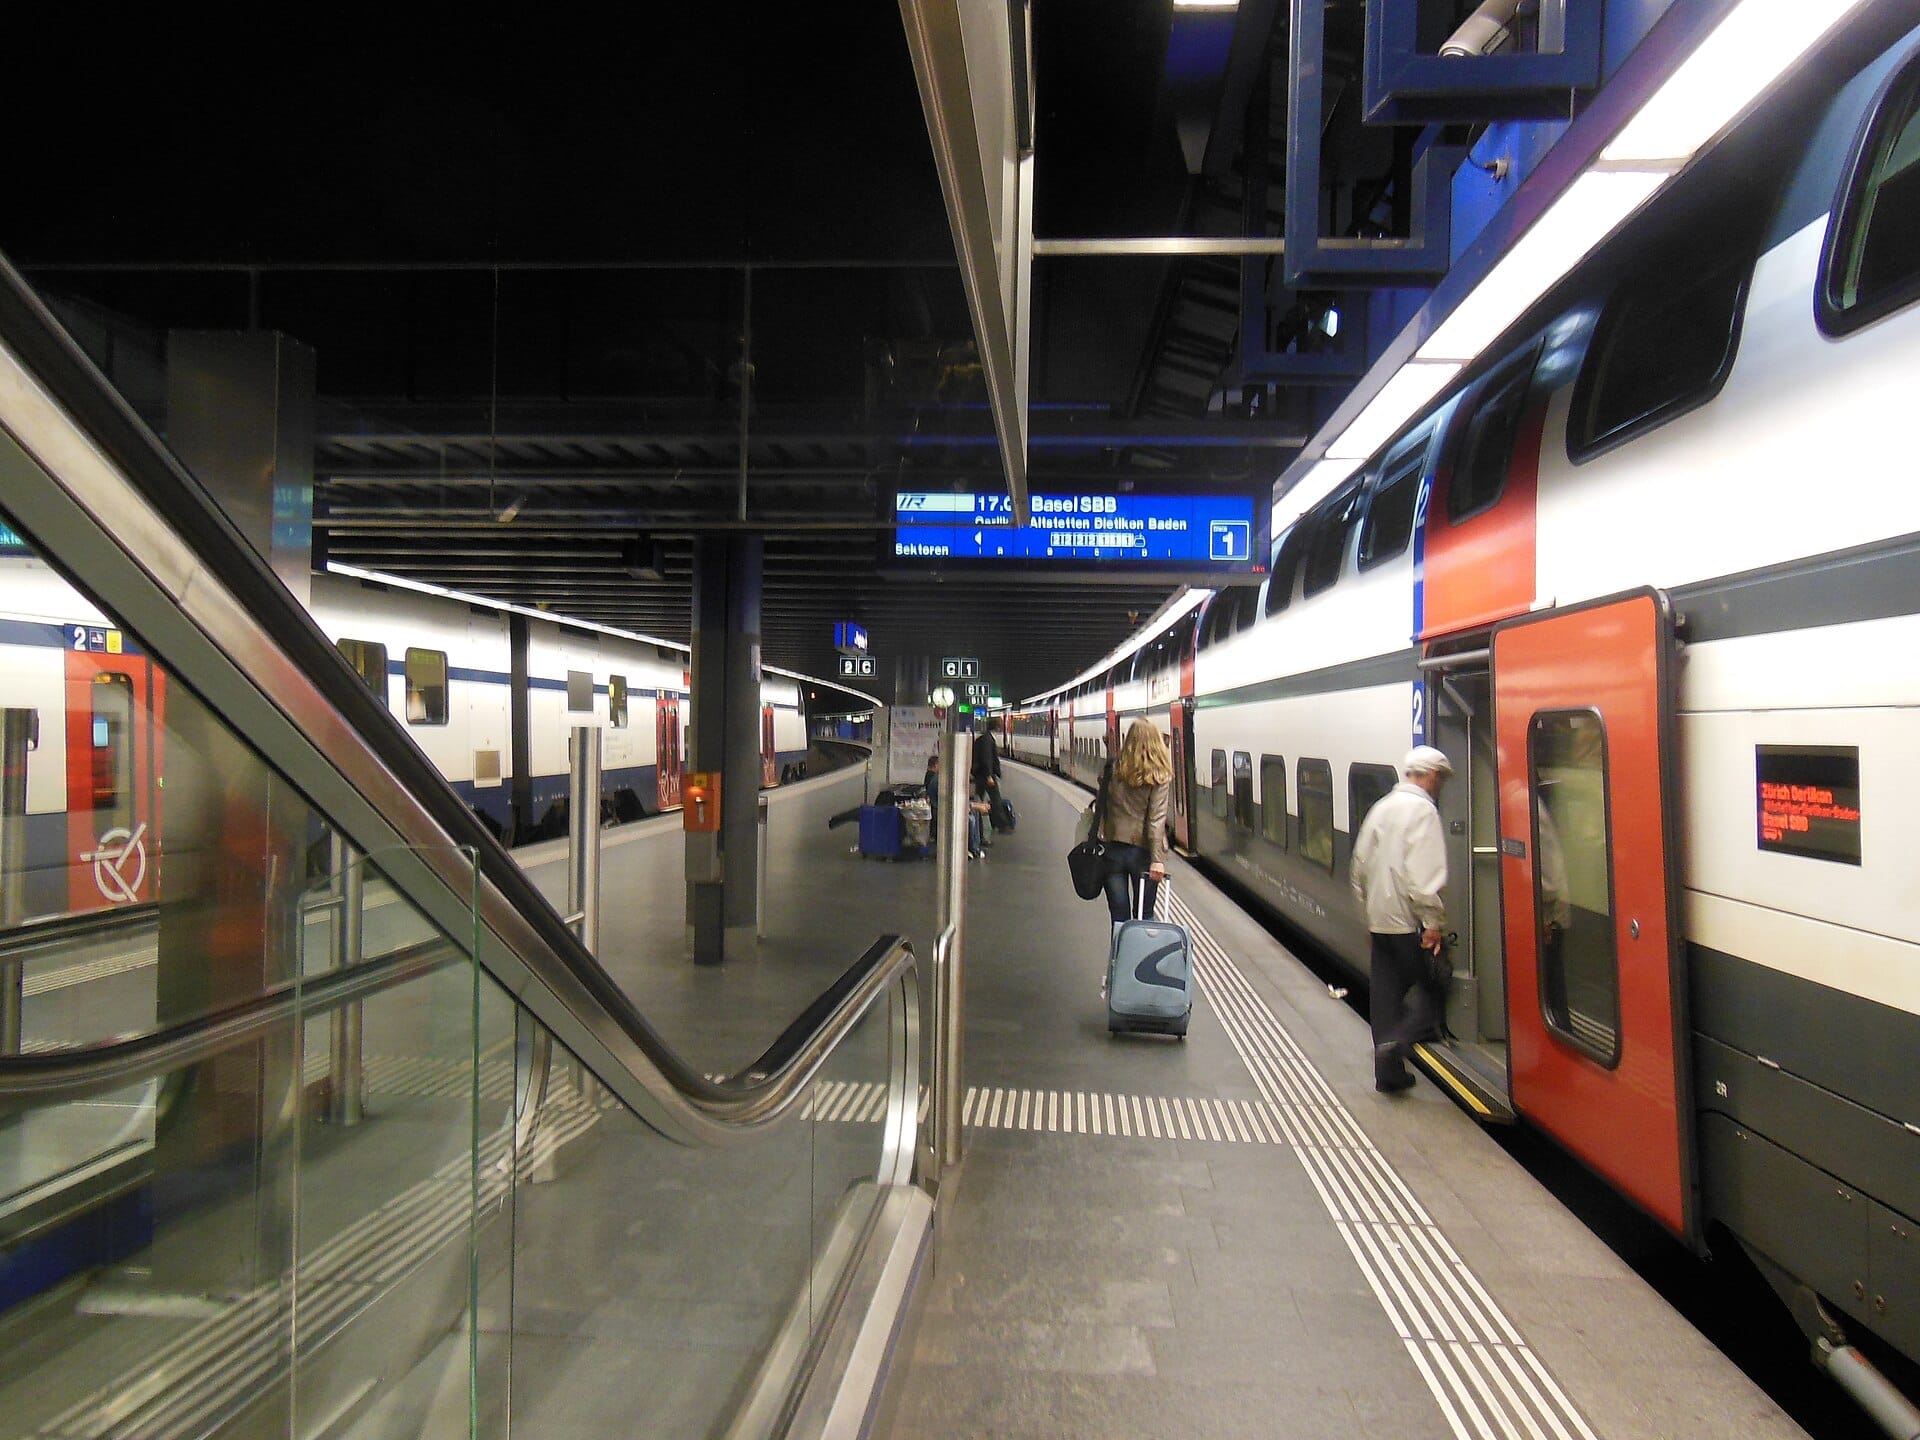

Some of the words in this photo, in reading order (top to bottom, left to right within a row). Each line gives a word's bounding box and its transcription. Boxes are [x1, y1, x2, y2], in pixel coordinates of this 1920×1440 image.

[1031, 495, 1078, 512] Basel
[1080, 496, 1117, 512] SBB
[1416, 483, 1430, 527] 2
[1030, 516, 1090, 529] Altstetten
[1148, 517, 1187, 530] Baden
[895, 543, 949, 556] Sektoren
[1222, 531, 1234, 556] 1
[74, 626, 86, 650] 2
[966, 663, 972, 676] 1
[1413, 689, 1422, 734] 2
